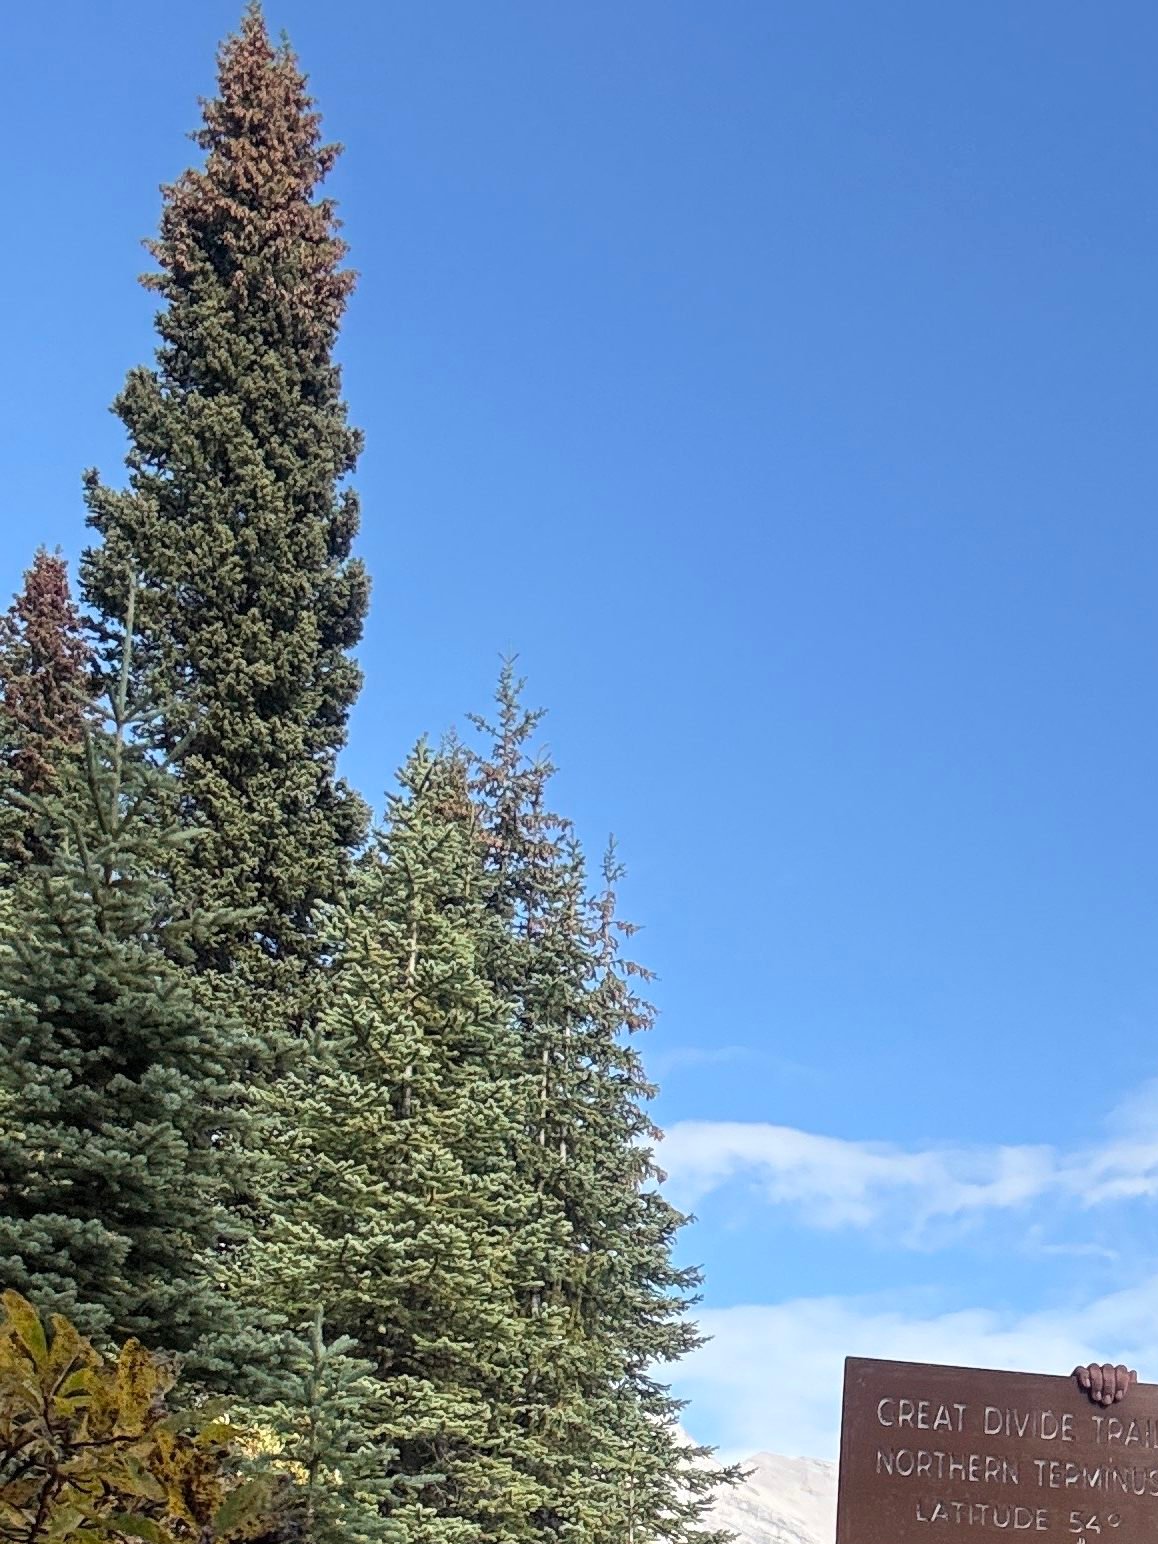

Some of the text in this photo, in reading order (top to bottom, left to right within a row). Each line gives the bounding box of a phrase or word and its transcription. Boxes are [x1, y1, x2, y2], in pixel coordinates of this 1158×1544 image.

[984, 1406, 1074, 1442] DIVIDE
[875, 1450, 1019, 1485] NORTHERN
[915, 1502, 1048, 1531] LATITUDE
